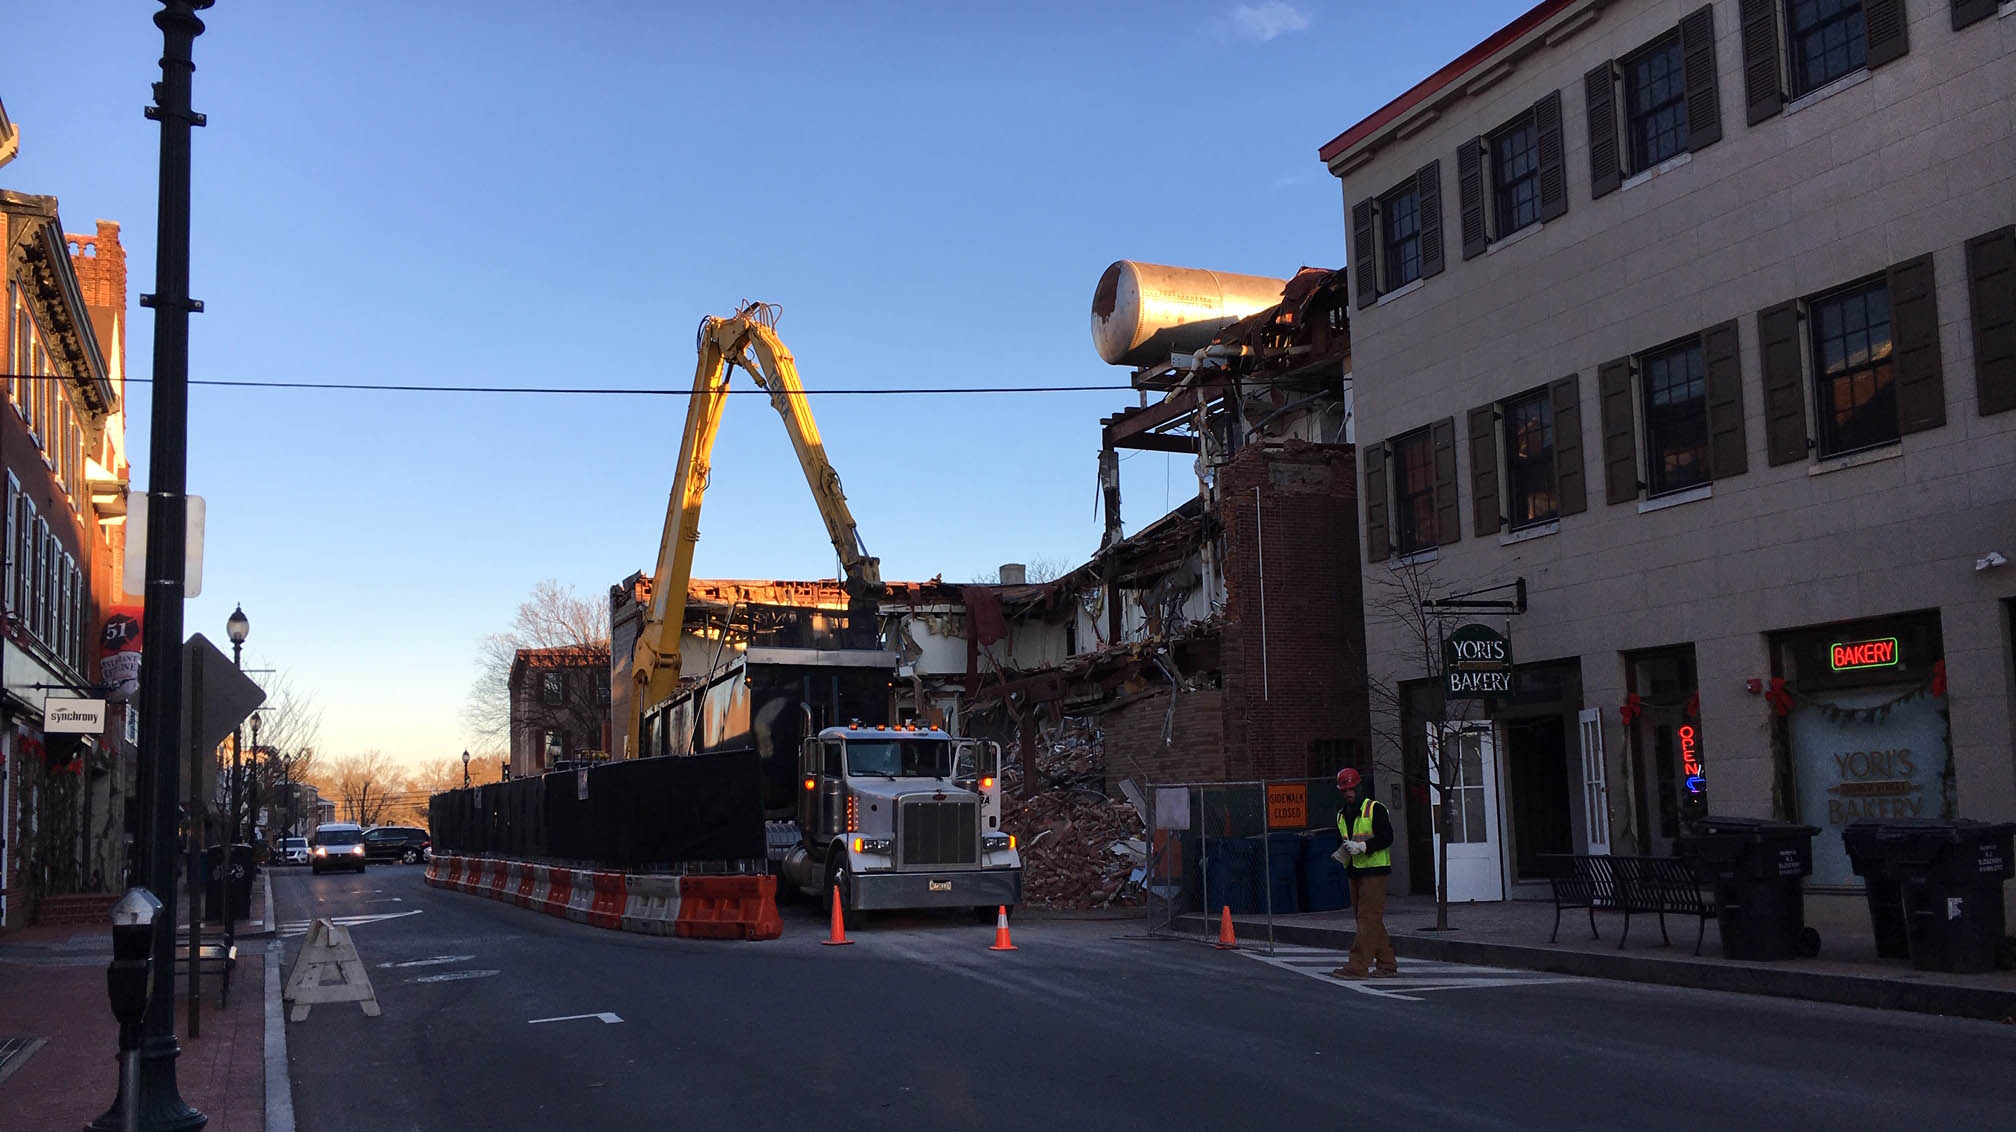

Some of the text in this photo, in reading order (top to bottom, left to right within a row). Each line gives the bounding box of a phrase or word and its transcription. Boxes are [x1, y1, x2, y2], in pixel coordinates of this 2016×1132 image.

[106, 623, 126, 640] 51
[1452, 640, 1504, 659] YORI'S
[1835, 641, 1893, 667] BAKERY
[1450, 672, 1511, 691] BAKERY
[50, 711, 98, 724] synchrony
[1679, 725, 1698, 775] OPEN
[1832, 748, 1914, 778] YORI'S
[1270, 792, 1305, 804] SIDEWALK
[1274, 807, 1301, 818] CLOSED
